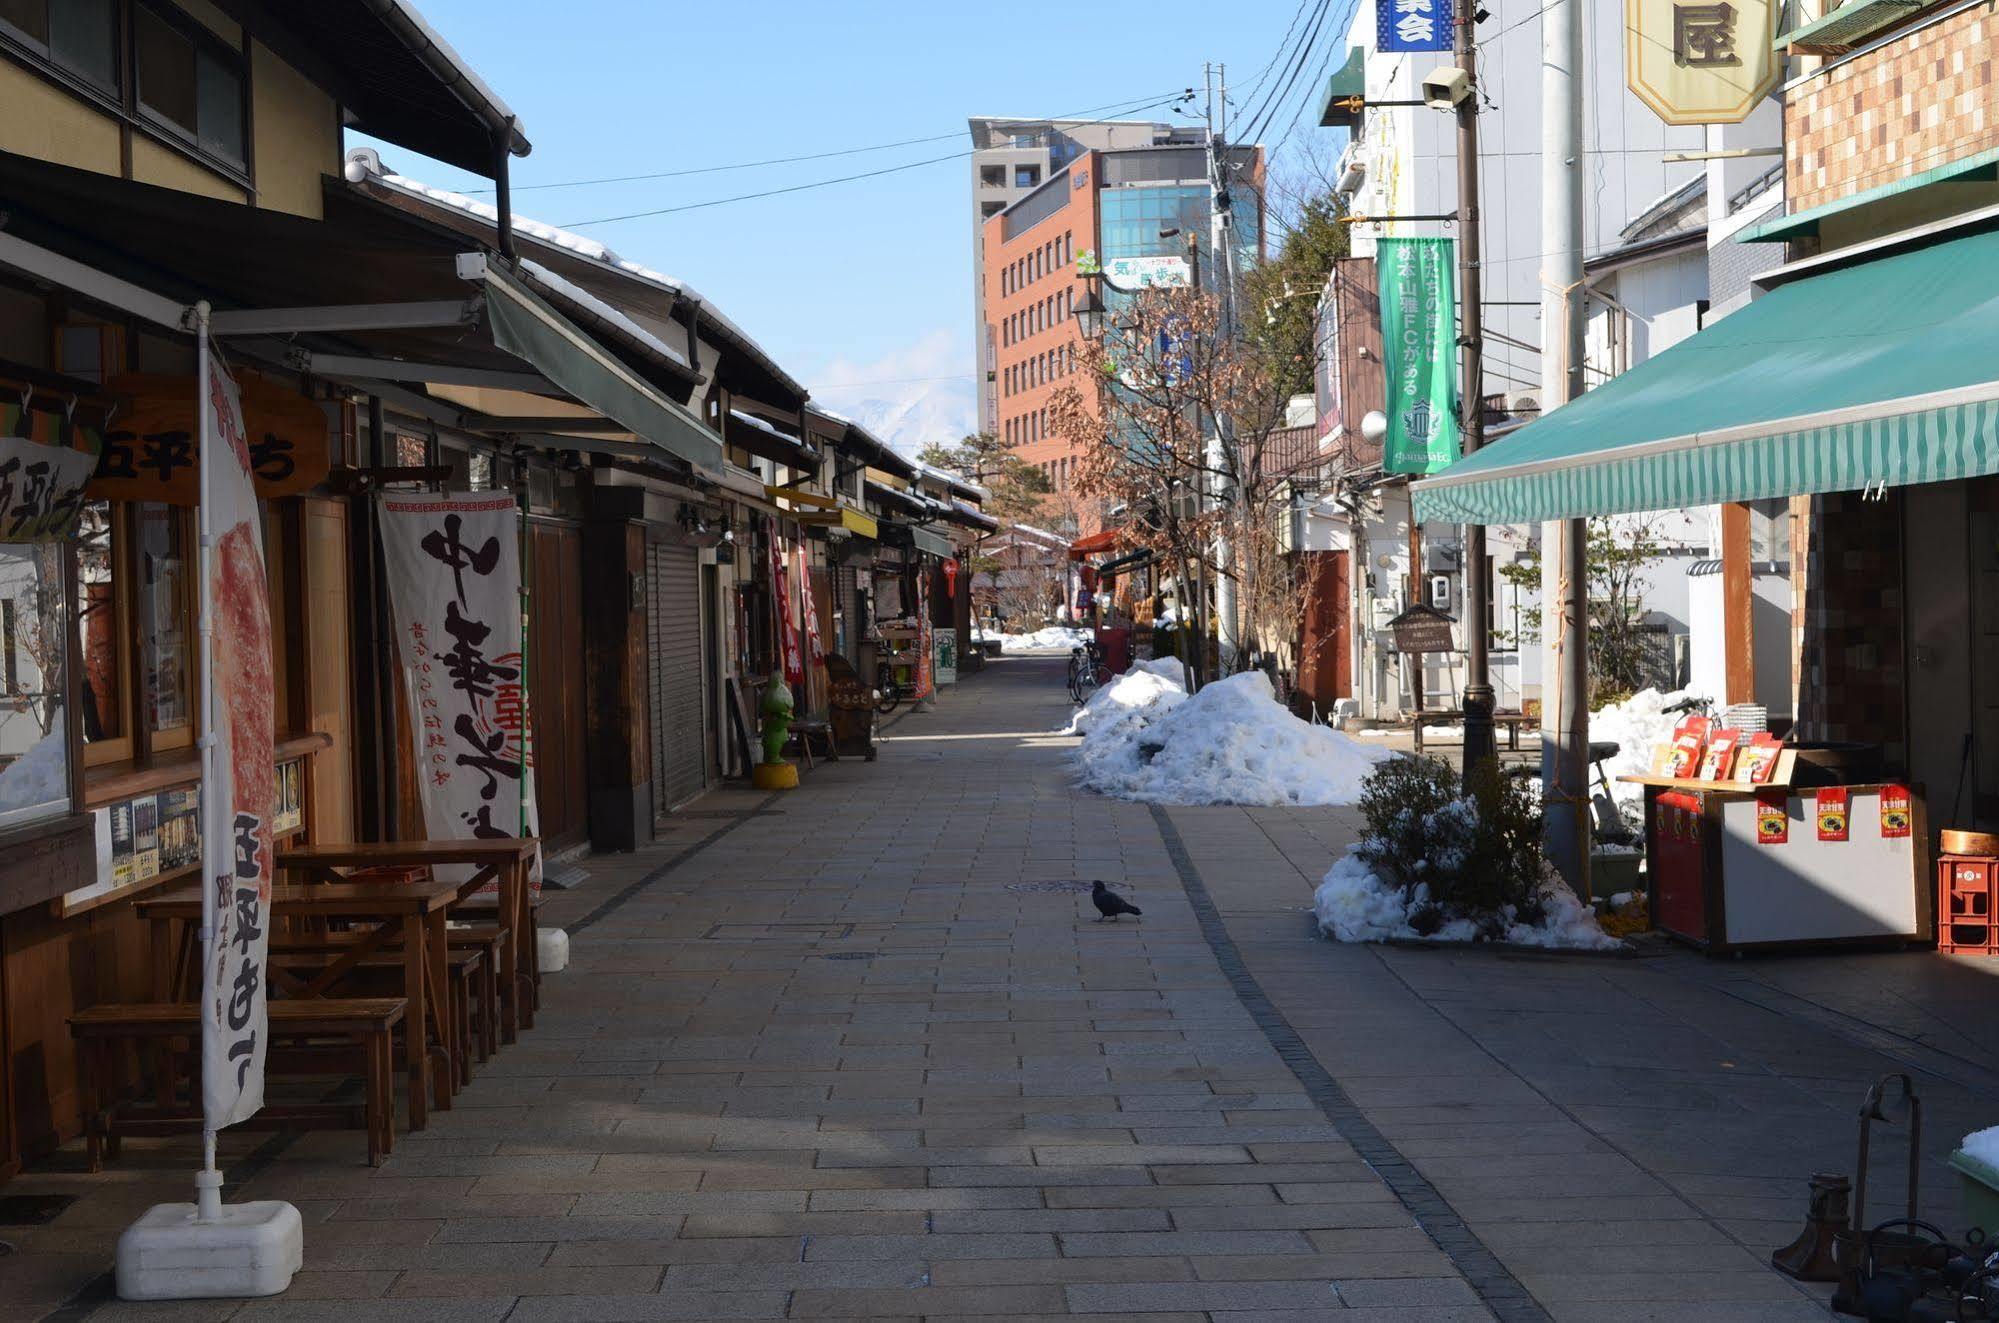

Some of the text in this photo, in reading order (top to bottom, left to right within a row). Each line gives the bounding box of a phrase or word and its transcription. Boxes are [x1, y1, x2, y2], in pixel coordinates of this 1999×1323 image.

[1673, 2, 1743, 68] 屋
[1396, 243, 1419, 396] 松本山雅FCがある
[99, 430, 295, 481] 五平ち
